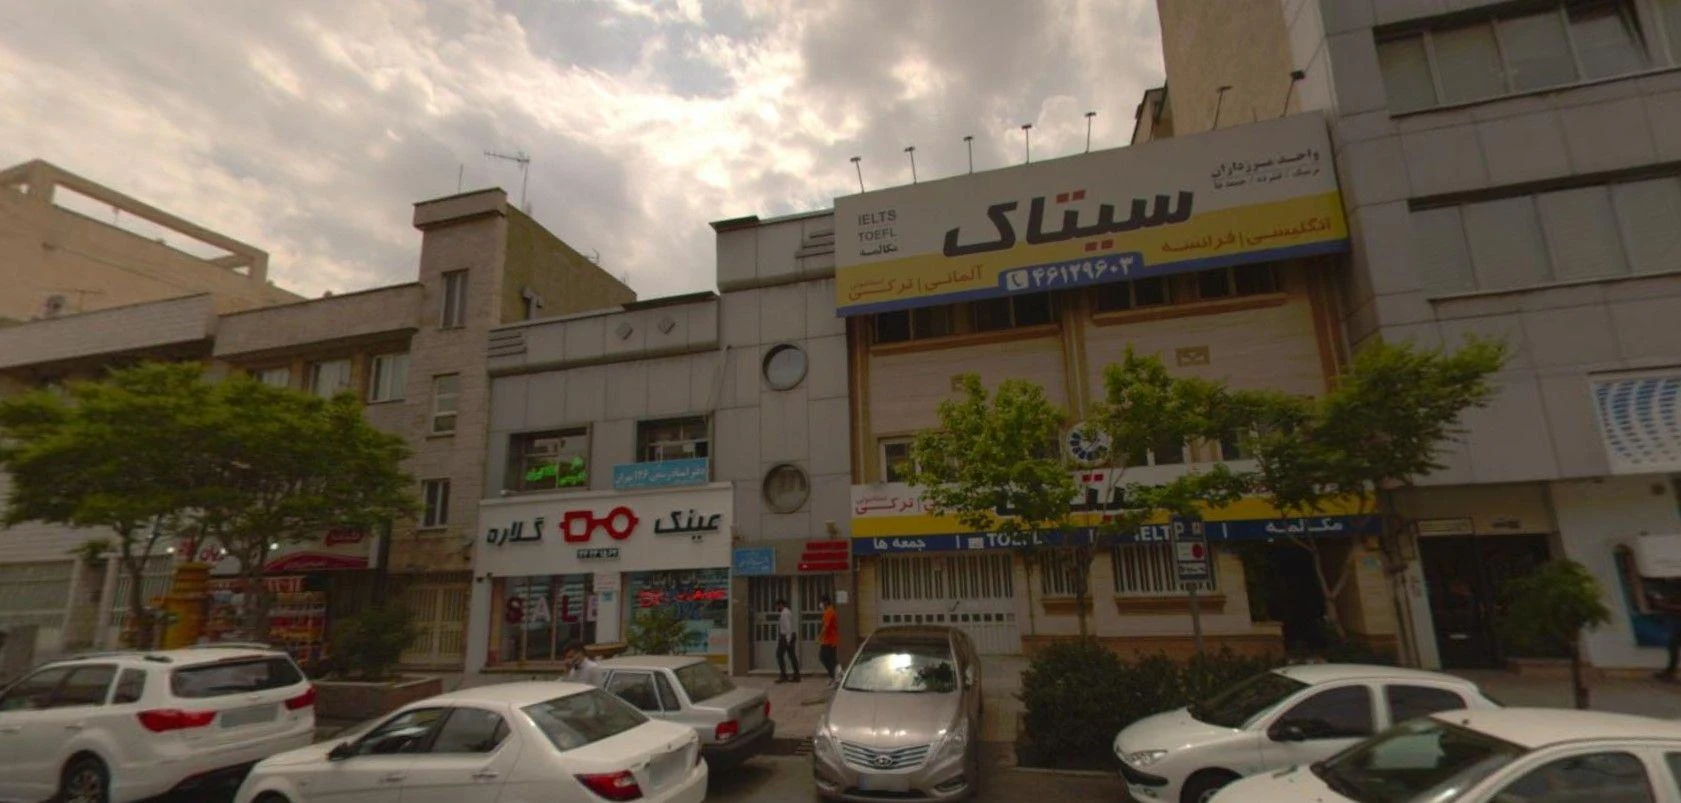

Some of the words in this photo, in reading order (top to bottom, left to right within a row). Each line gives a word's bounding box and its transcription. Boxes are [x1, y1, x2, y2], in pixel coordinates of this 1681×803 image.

[858, 209, 897, 226] IELTS
[943, 189, 1195, 258] سیتاک
[859, 227, 897, 242] TOEFL
[1246, 215, 1333, 246] انگلیسی
[859, 243, 899, 257] مکالمه
[1160, 230, 1236, 252] فرانسه
[924, 263, 985, 292] آلمانی
[848, 276, 915, 302] ترکی
[855, 497, 914, 515] ترکی
[486, 517, 545, 547] گلاره
[654, 509, 721, 541] عینک
[1264, 517, 1344, 534] مکلمه
[872, 535, 888, 550] ها
[891, 538, 927, 551] جمعه
